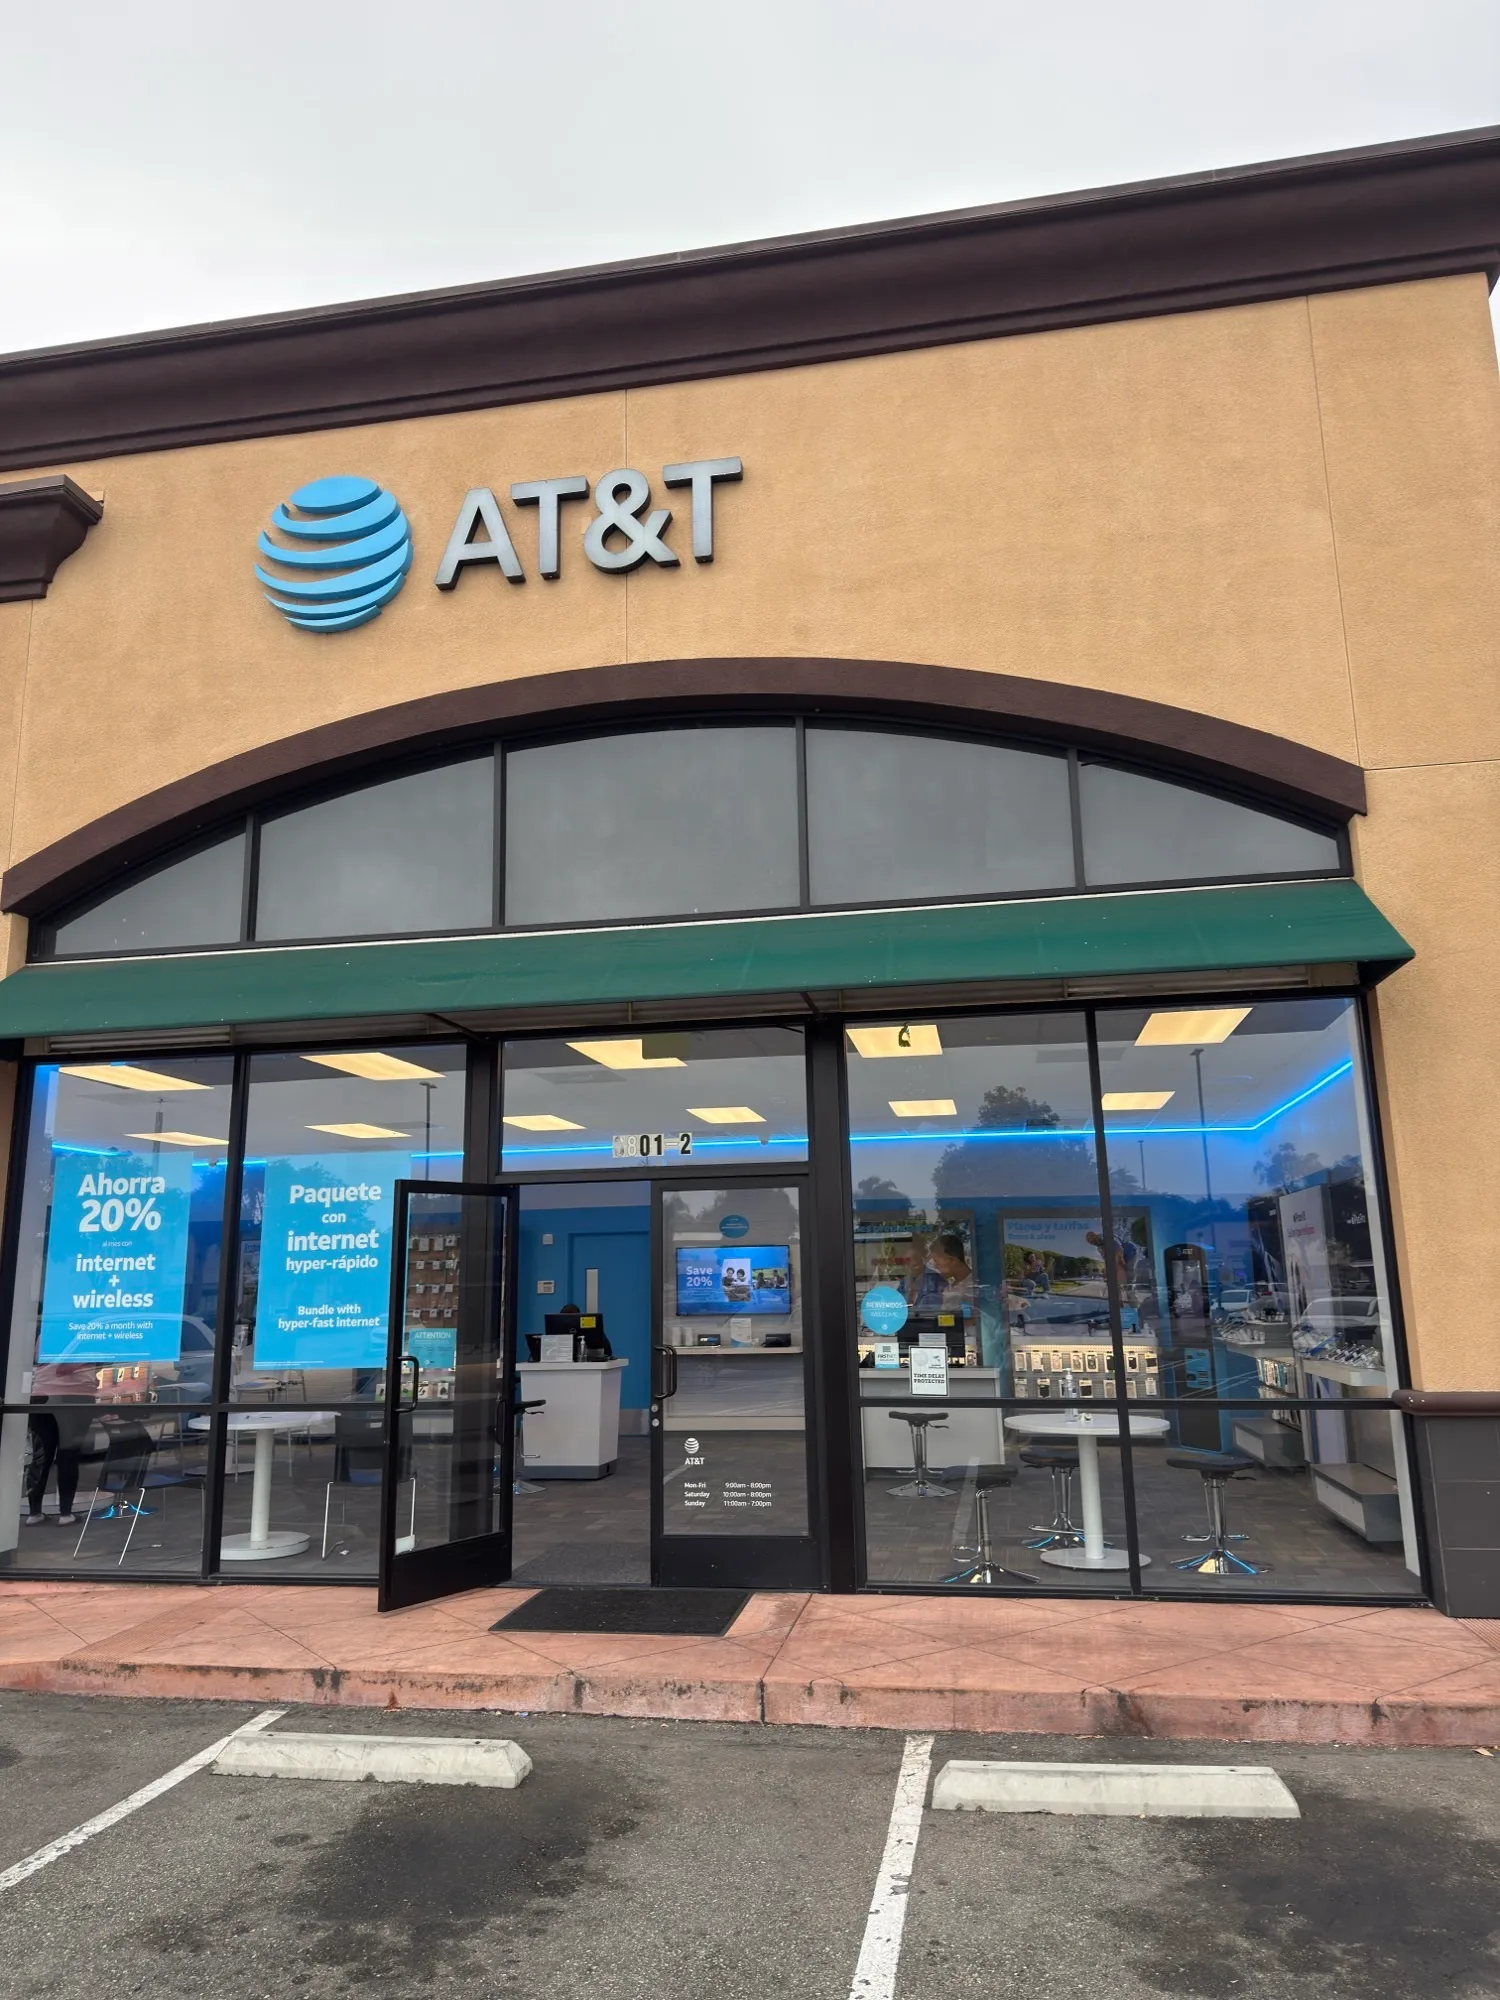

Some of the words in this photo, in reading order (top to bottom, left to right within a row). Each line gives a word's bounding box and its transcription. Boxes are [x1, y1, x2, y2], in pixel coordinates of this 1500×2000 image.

[435, 457, 743, 590] AT&T
[77, 1172, 165, 1198] Ahorra
[289, 1182, 382, 1208] Paquete
[79, 1198, 162, 1232] 20%
[321, 1212, 346, 1223] con
[287, 1229, 379, 1252] internet
[75, 1253, 156, 1272] internet
[285, 1254, 379, 1274] hyper-rápido
[686, 1266, 713, 1276] Save
[108, 1274, 120, 1287] +
[686, 1276, 713, 1287] 20%
[73, 1289, 154, 1309] wireless
[298, 1305, 334, 1315] Bundle
[336, 1303, 361, 1314] with
[68, 1322, 86, 1331] Save
[87, 1322, 102, 1330] 20%
[111, 1321, 136, 1329] month
[136, 1321, 153, 1329] with
[278, 1316, 334, 1331] hyper-fast
[336, 1316, 380, 1327] internet
[77, 1331, 106, 1340] internet
[114, 1331, 143, 1339] wireless
[414, 1331, 452, 1340] ATTENTION
[684, 1457, 705, 1465] AT&T
[684, 1491, 710, 1499] Saturday
[750, 1491, 772, 1499] 8:00pm
[684, 1500, 706, 1508] Sunday
[751, 1500, 772, 1508] 7:00pm
